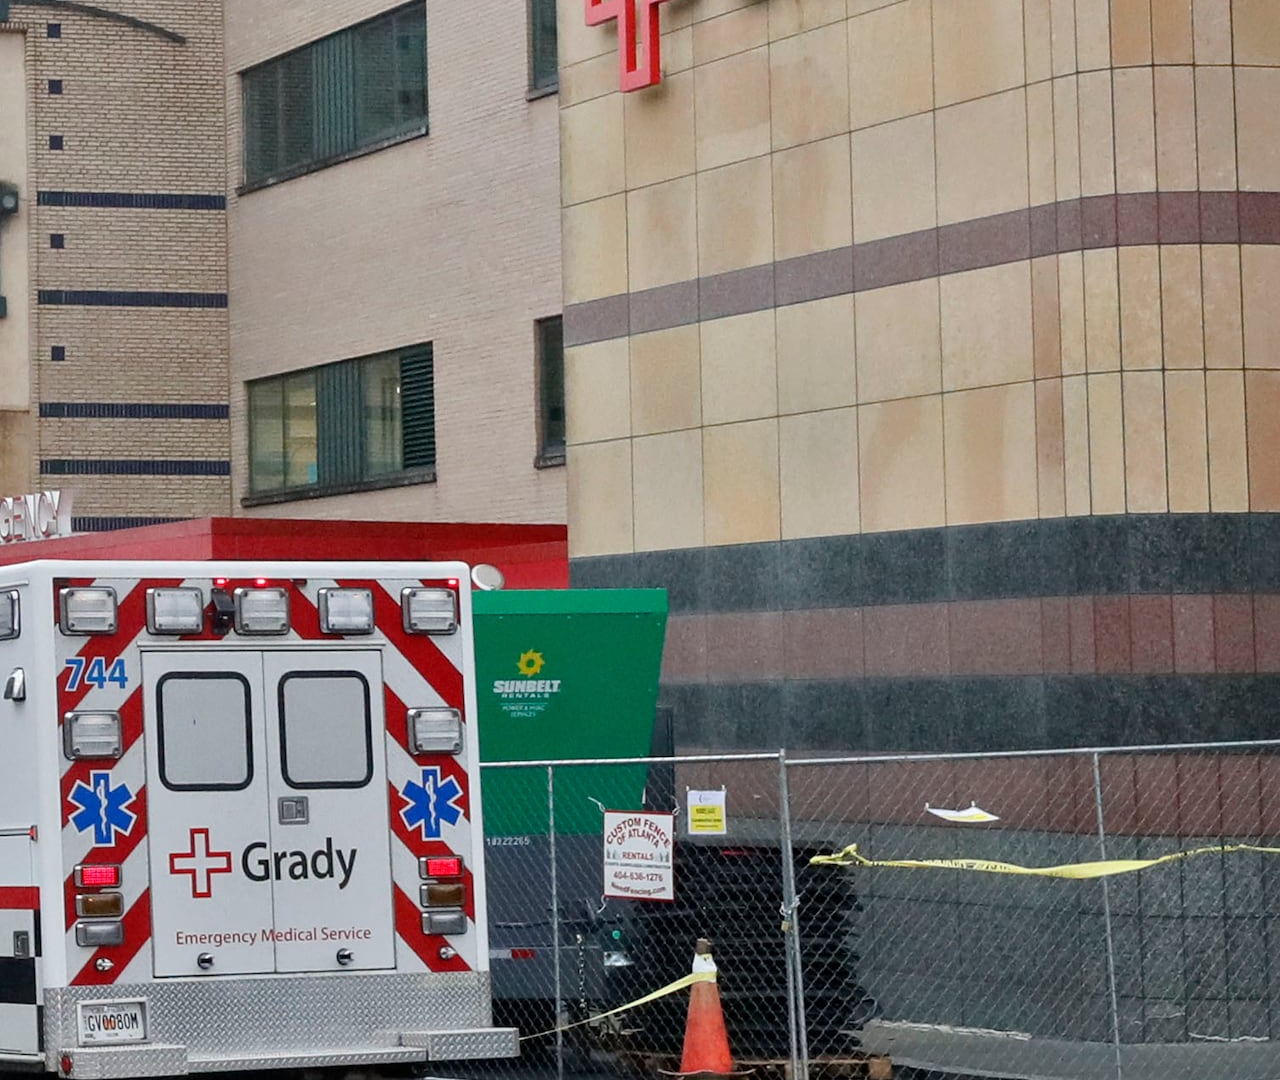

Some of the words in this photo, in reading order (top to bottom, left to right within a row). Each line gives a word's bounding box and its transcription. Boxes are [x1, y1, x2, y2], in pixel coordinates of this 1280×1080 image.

[64, 658, 129, 689] 744
[493, 680, 560, 693] SUNBELT
[606, 817, 641, 845] CUSTOM
[644, 819, 671, 848] FENCE
[616, 832, 626, 846] OF
[628, 828, 659, 848] ATLANTA
[241, 837, 358, 889] Grady
[622, 851, 654, 860] RENTALS
[176, 930, 257, 947] Emergency
[260, 927, 317, 943] Medical
[321, 926, 372, 941] Service
